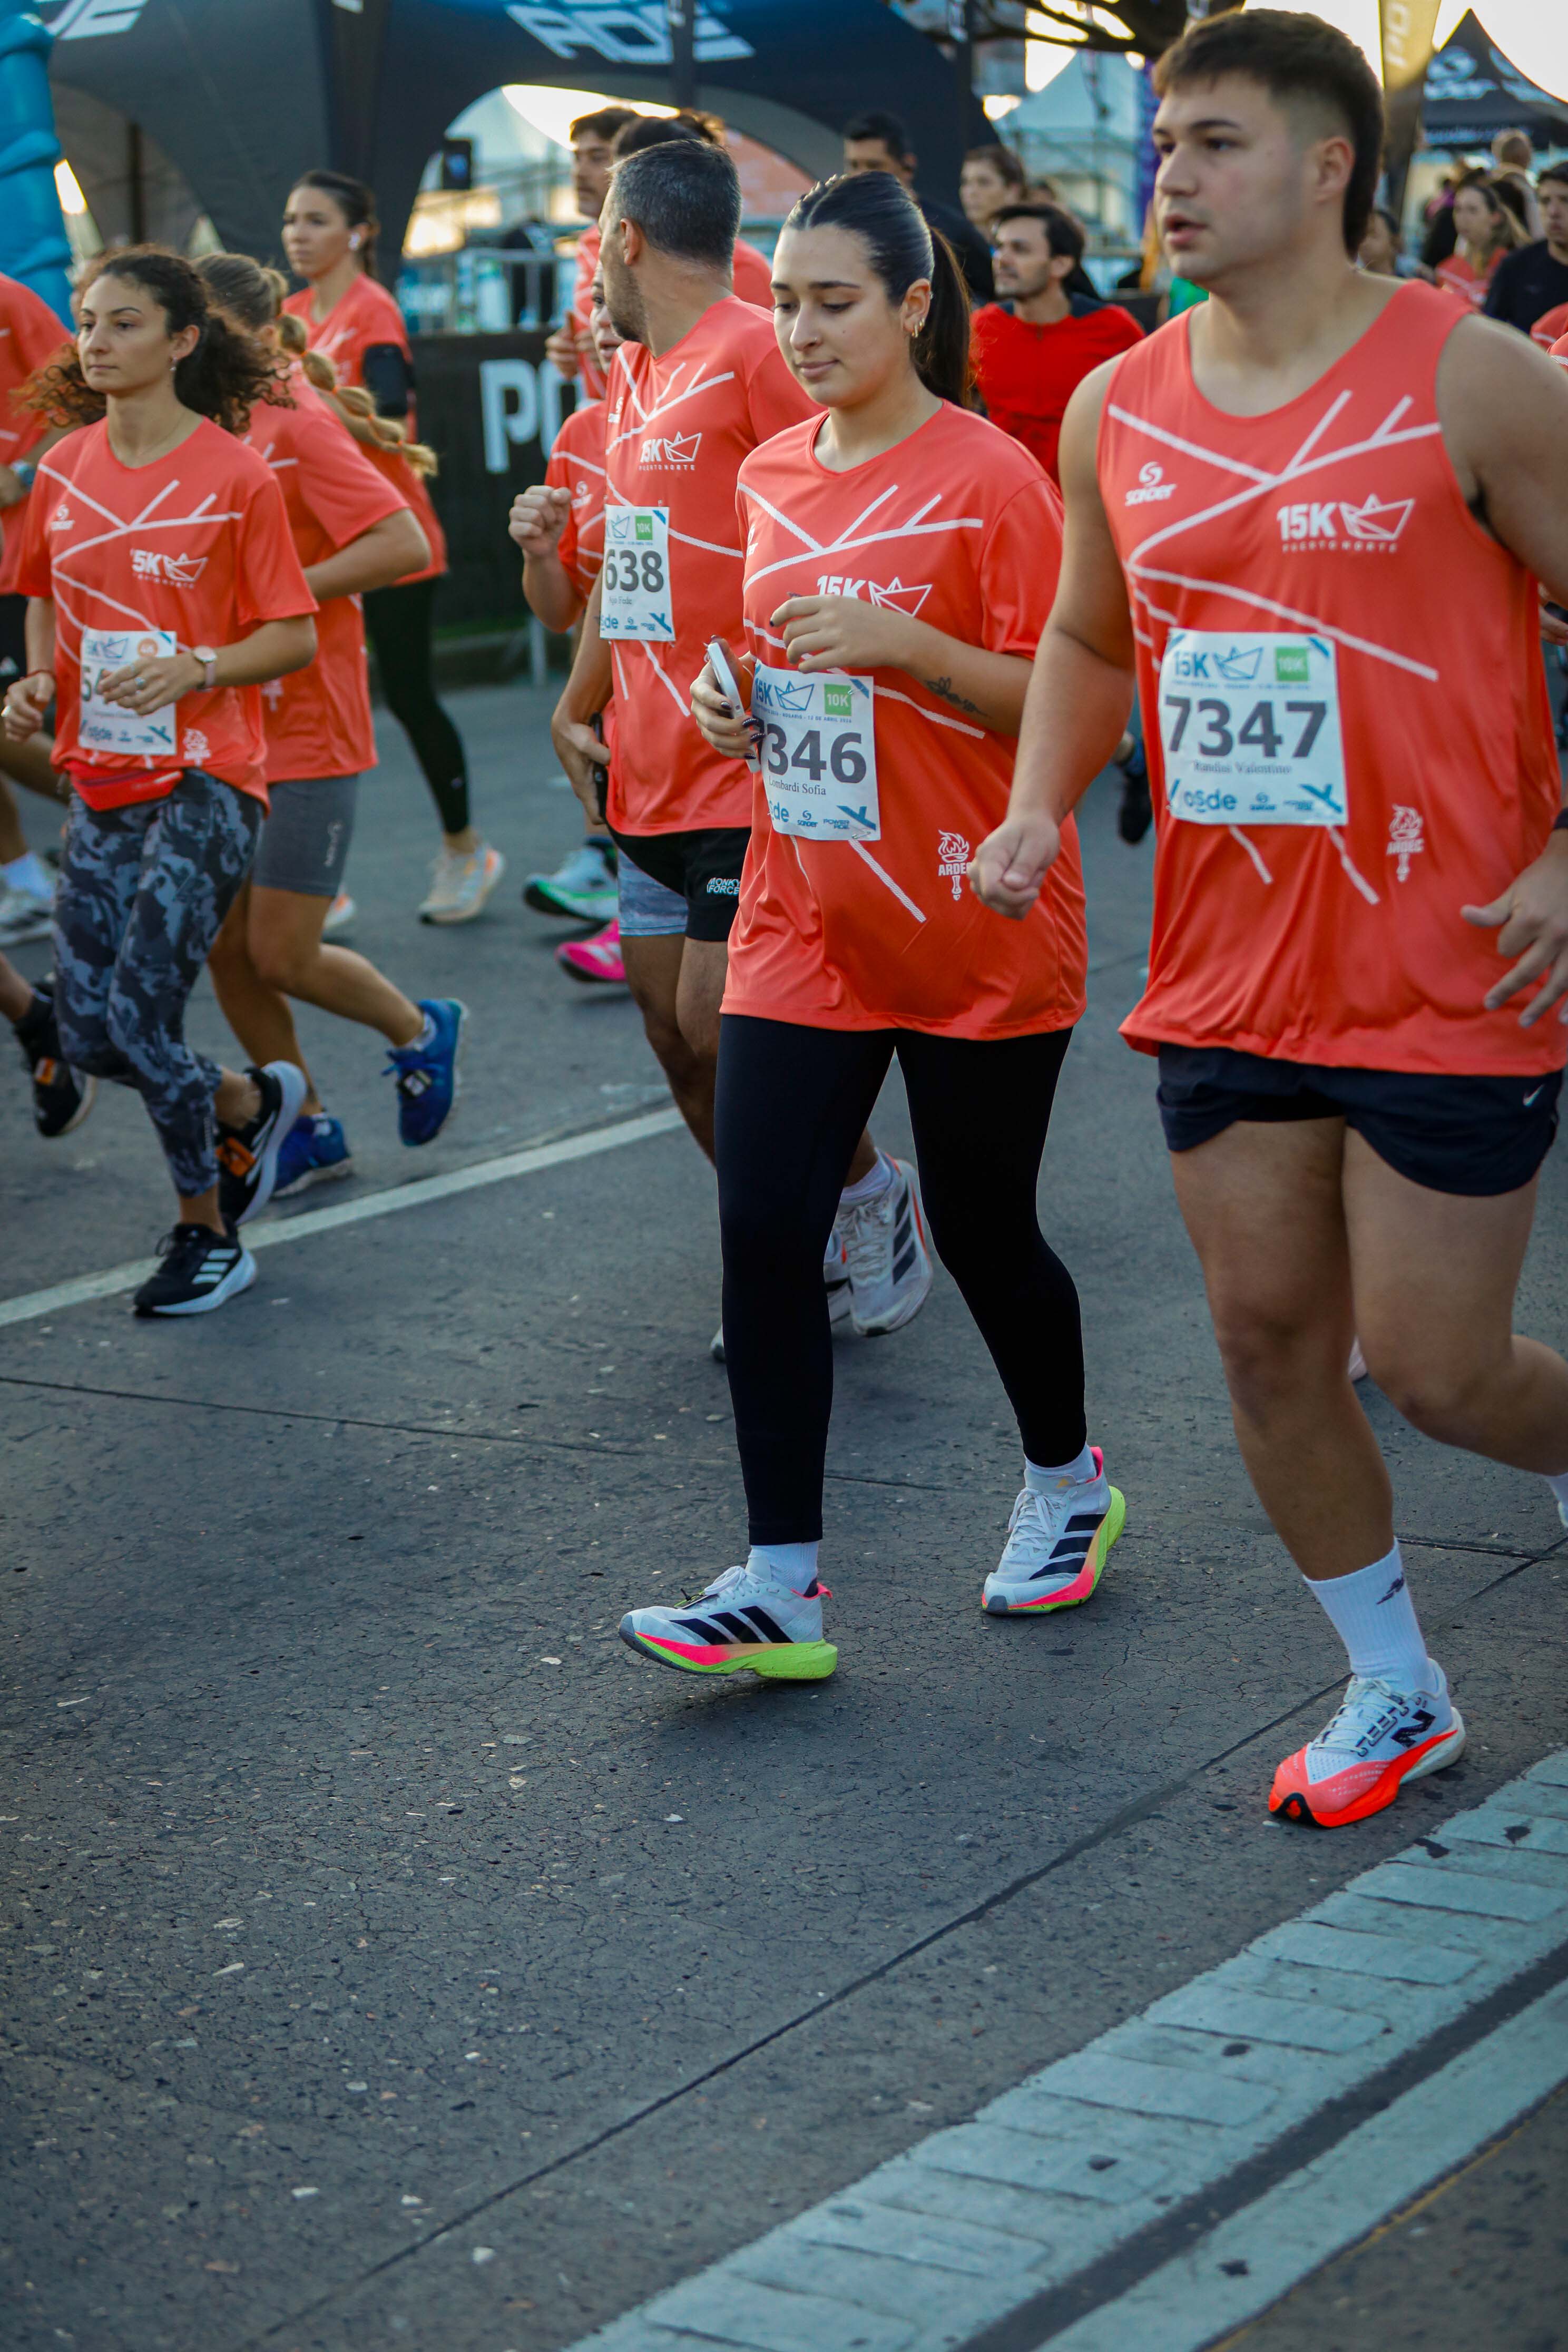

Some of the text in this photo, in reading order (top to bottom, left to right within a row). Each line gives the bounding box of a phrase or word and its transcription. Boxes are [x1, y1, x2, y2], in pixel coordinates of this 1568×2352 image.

[1277, 502, 1338, 541] 15K
[817, 575, 866, 599] 15K
[1174, 649, 1209, 678] 15K
[755, 678, 773, 707] 15K
[827, 693, 849, 707] 10K
[1164, 695, 1327, 758] 7347
[769, 775, 826, 796] Lombardi Sofia
[1184, 788, 1237, 812] osde
[708, 885, 740, 896] FORCE
